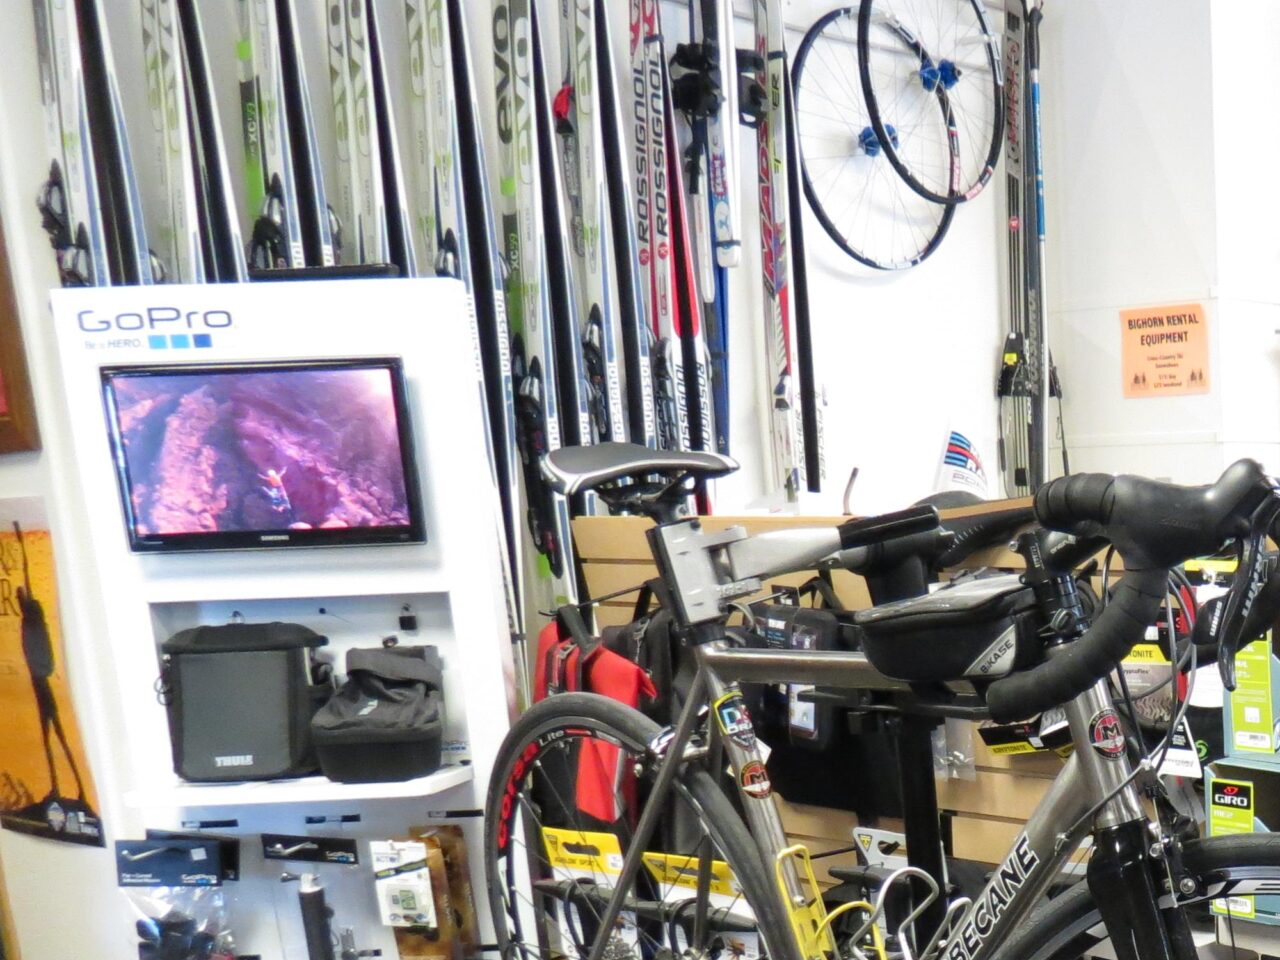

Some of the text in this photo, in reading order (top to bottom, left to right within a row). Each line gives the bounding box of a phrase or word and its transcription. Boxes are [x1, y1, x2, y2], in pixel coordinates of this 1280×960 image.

[633, 60, 650, 244] ROSSIGNOL
[650, 52, 669, 238] ROSSIGNOL
[77, 307, 232, 332] GoPro
[1128, 313, 1199, 330] BIGHORN RENTAL
[1140, 331, 1188, 347] EQUIPMENT
[1209, 600, 1223, 636] SRAM
[538, 729, 565, 748] Lite
[215, 754, 254, 767] THULE
[1213, 794, 1248, 807] GIRO
